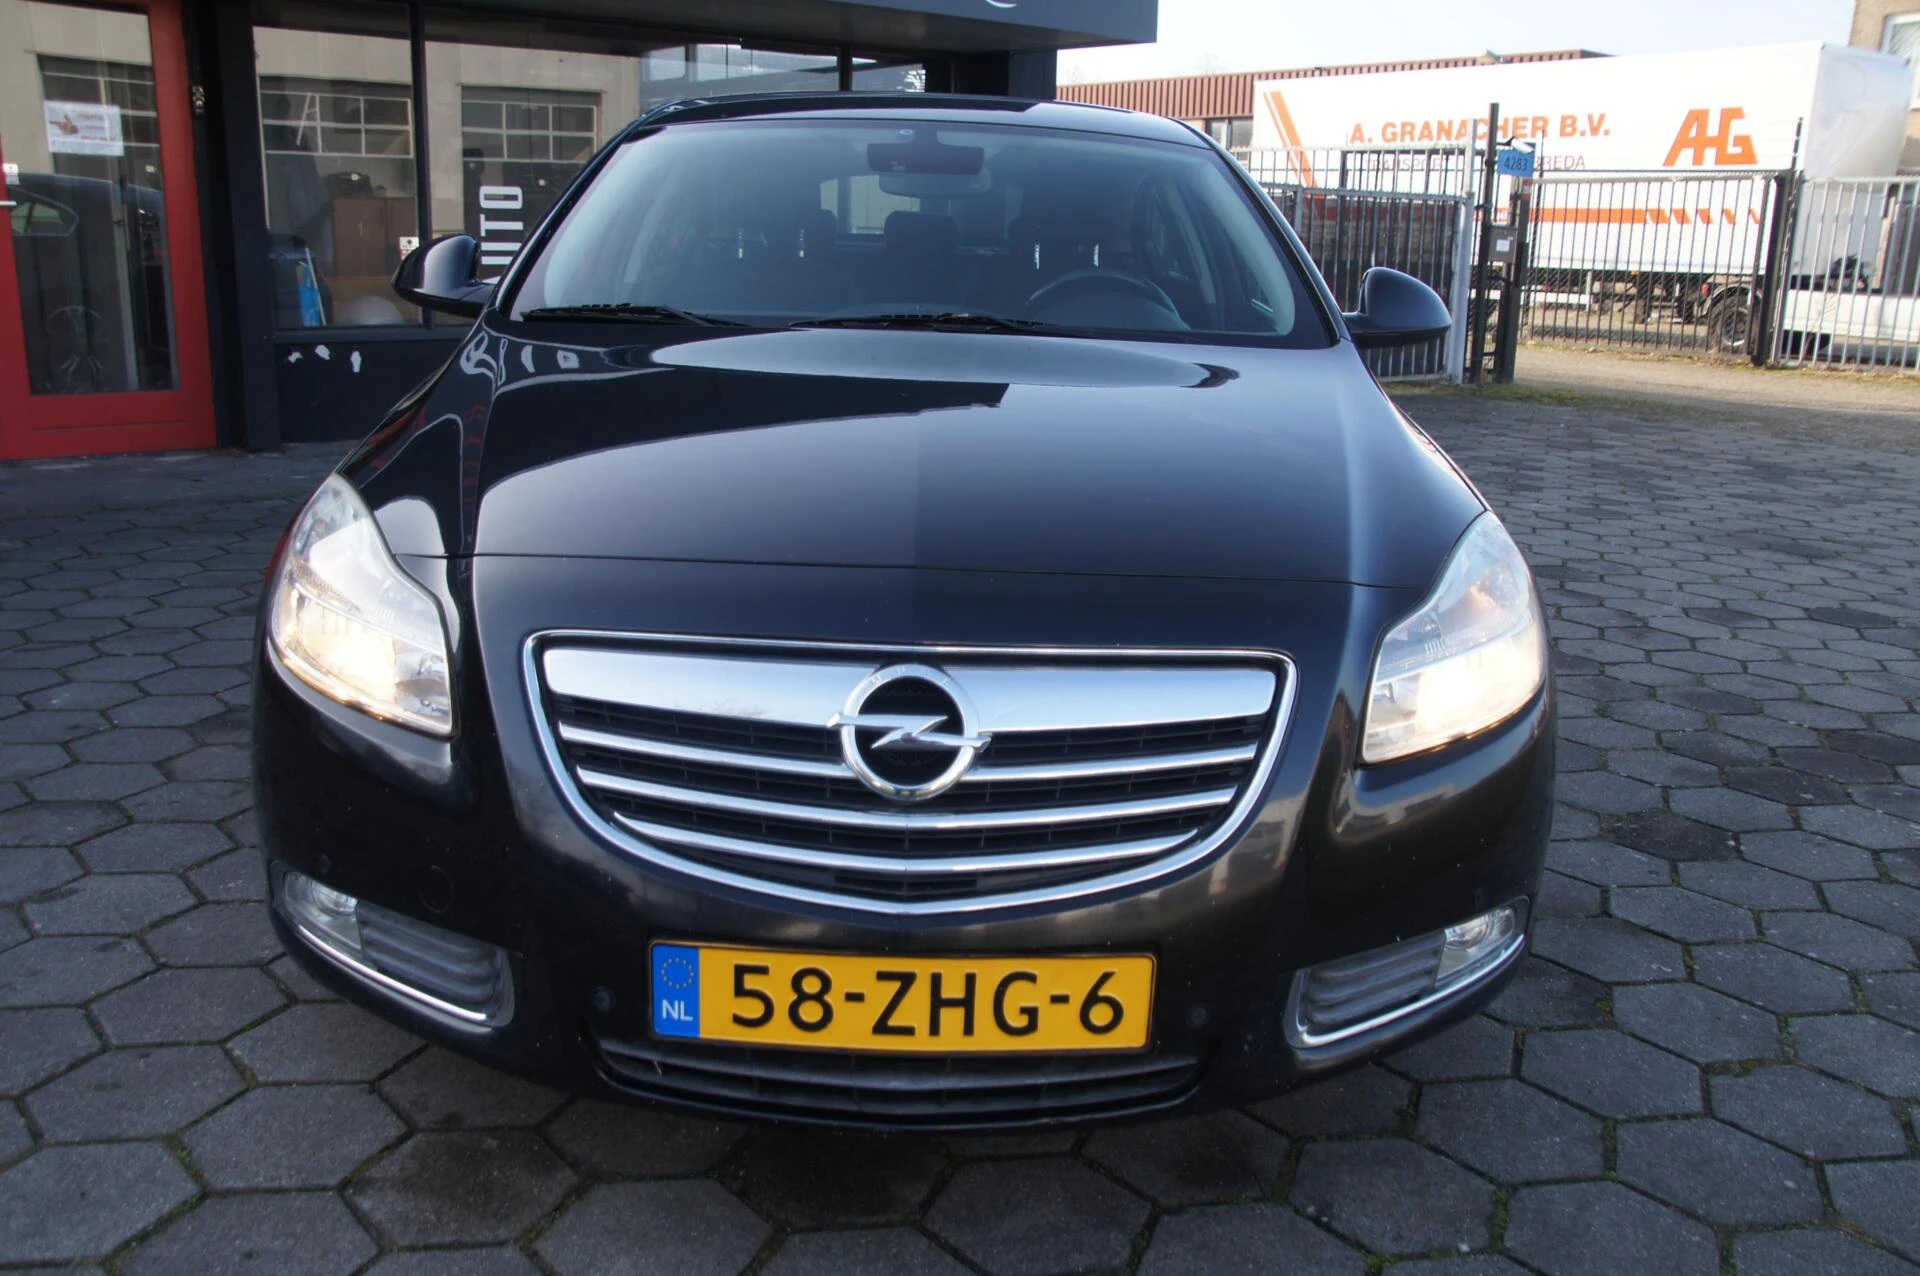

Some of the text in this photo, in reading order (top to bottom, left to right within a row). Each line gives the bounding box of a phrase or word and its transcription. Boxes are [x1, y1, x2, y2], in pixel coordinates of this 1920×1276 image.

[1350, 113, 1611, 144] A. GRANACHER B.V.
[1663, 107, 1758, 166] AHG
[1504, 156, 1528, 171] 4283
[479, 185, 524, 284] UTO
[662, 999, 693, 1021] NL
[732, 963, 1124, 1037] 58-ZHG-6
